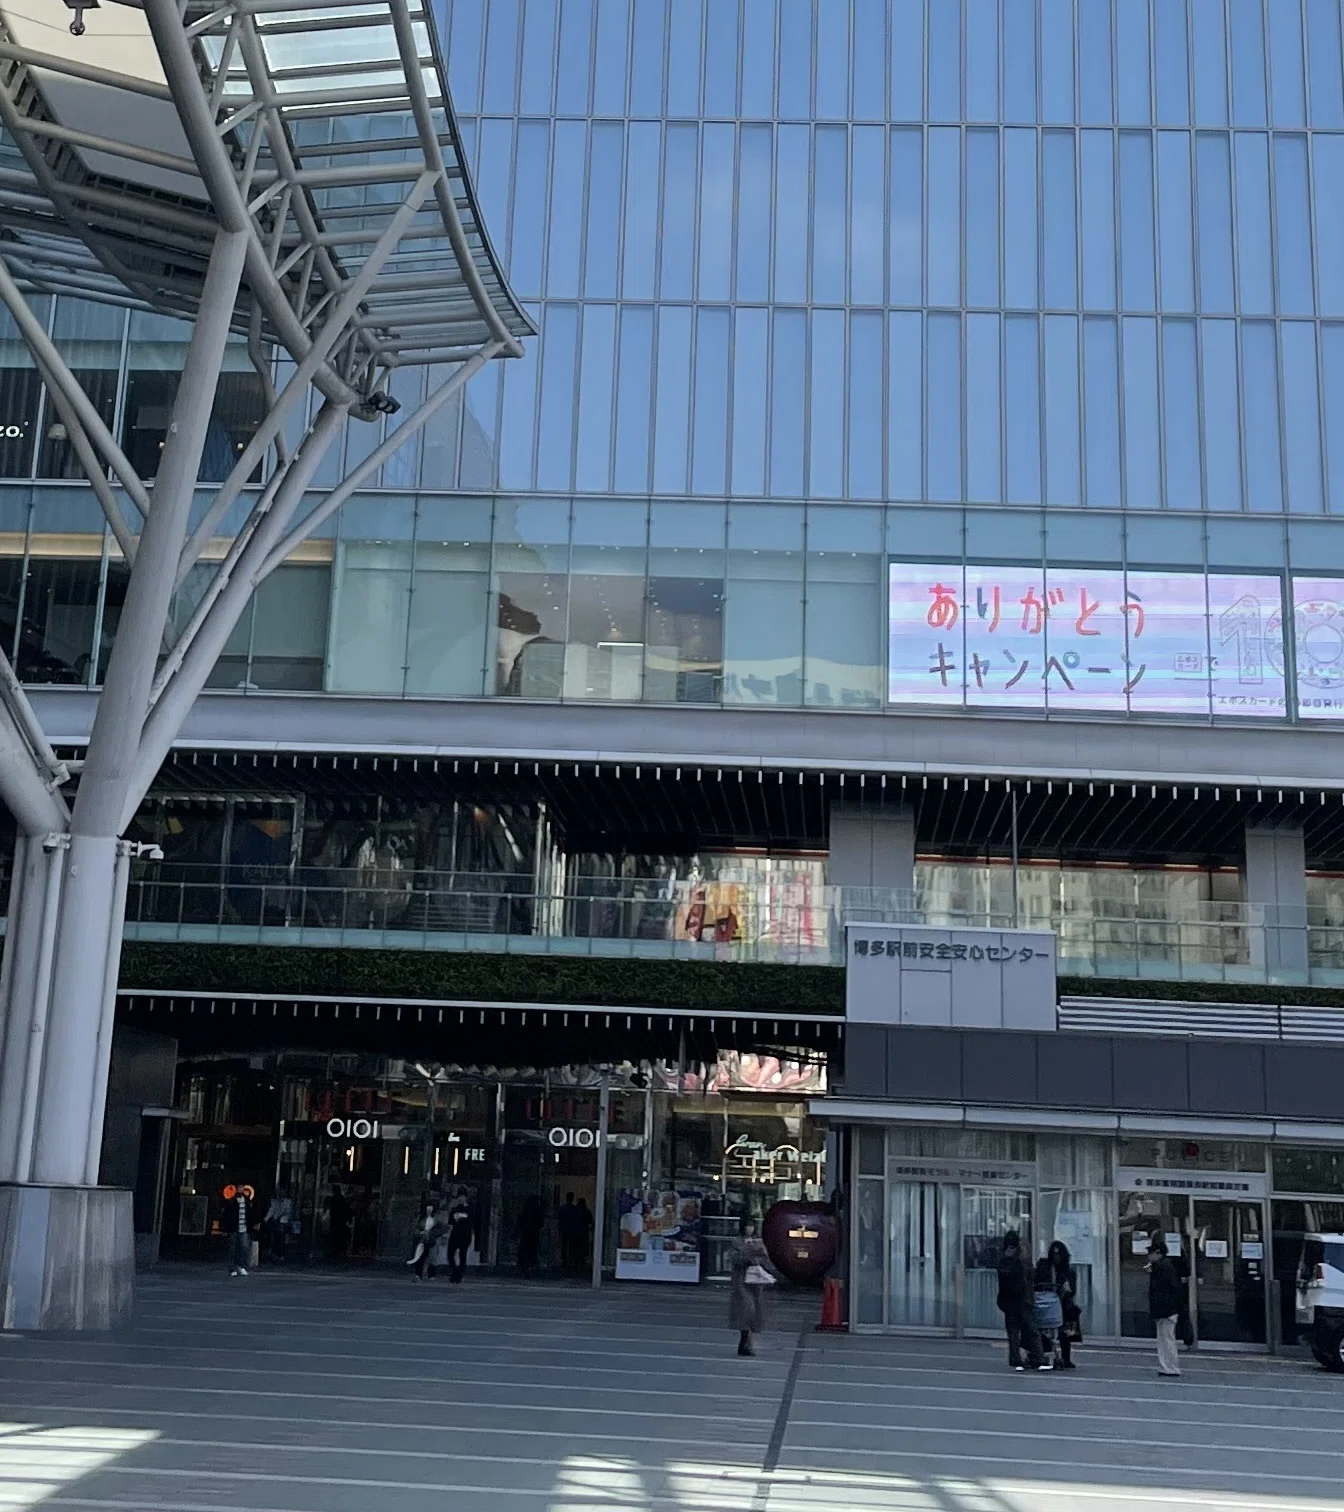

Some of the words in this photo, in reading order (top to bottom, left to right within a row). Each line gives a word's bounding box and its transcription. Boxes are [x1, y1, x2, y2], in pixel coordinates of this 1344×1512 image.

[927, 582, 1145, 639] ありがとう
[929, 642, 1147, 694] キャンペーン
[854, 939, 1049, 963] 博多駅前安全安心センター
